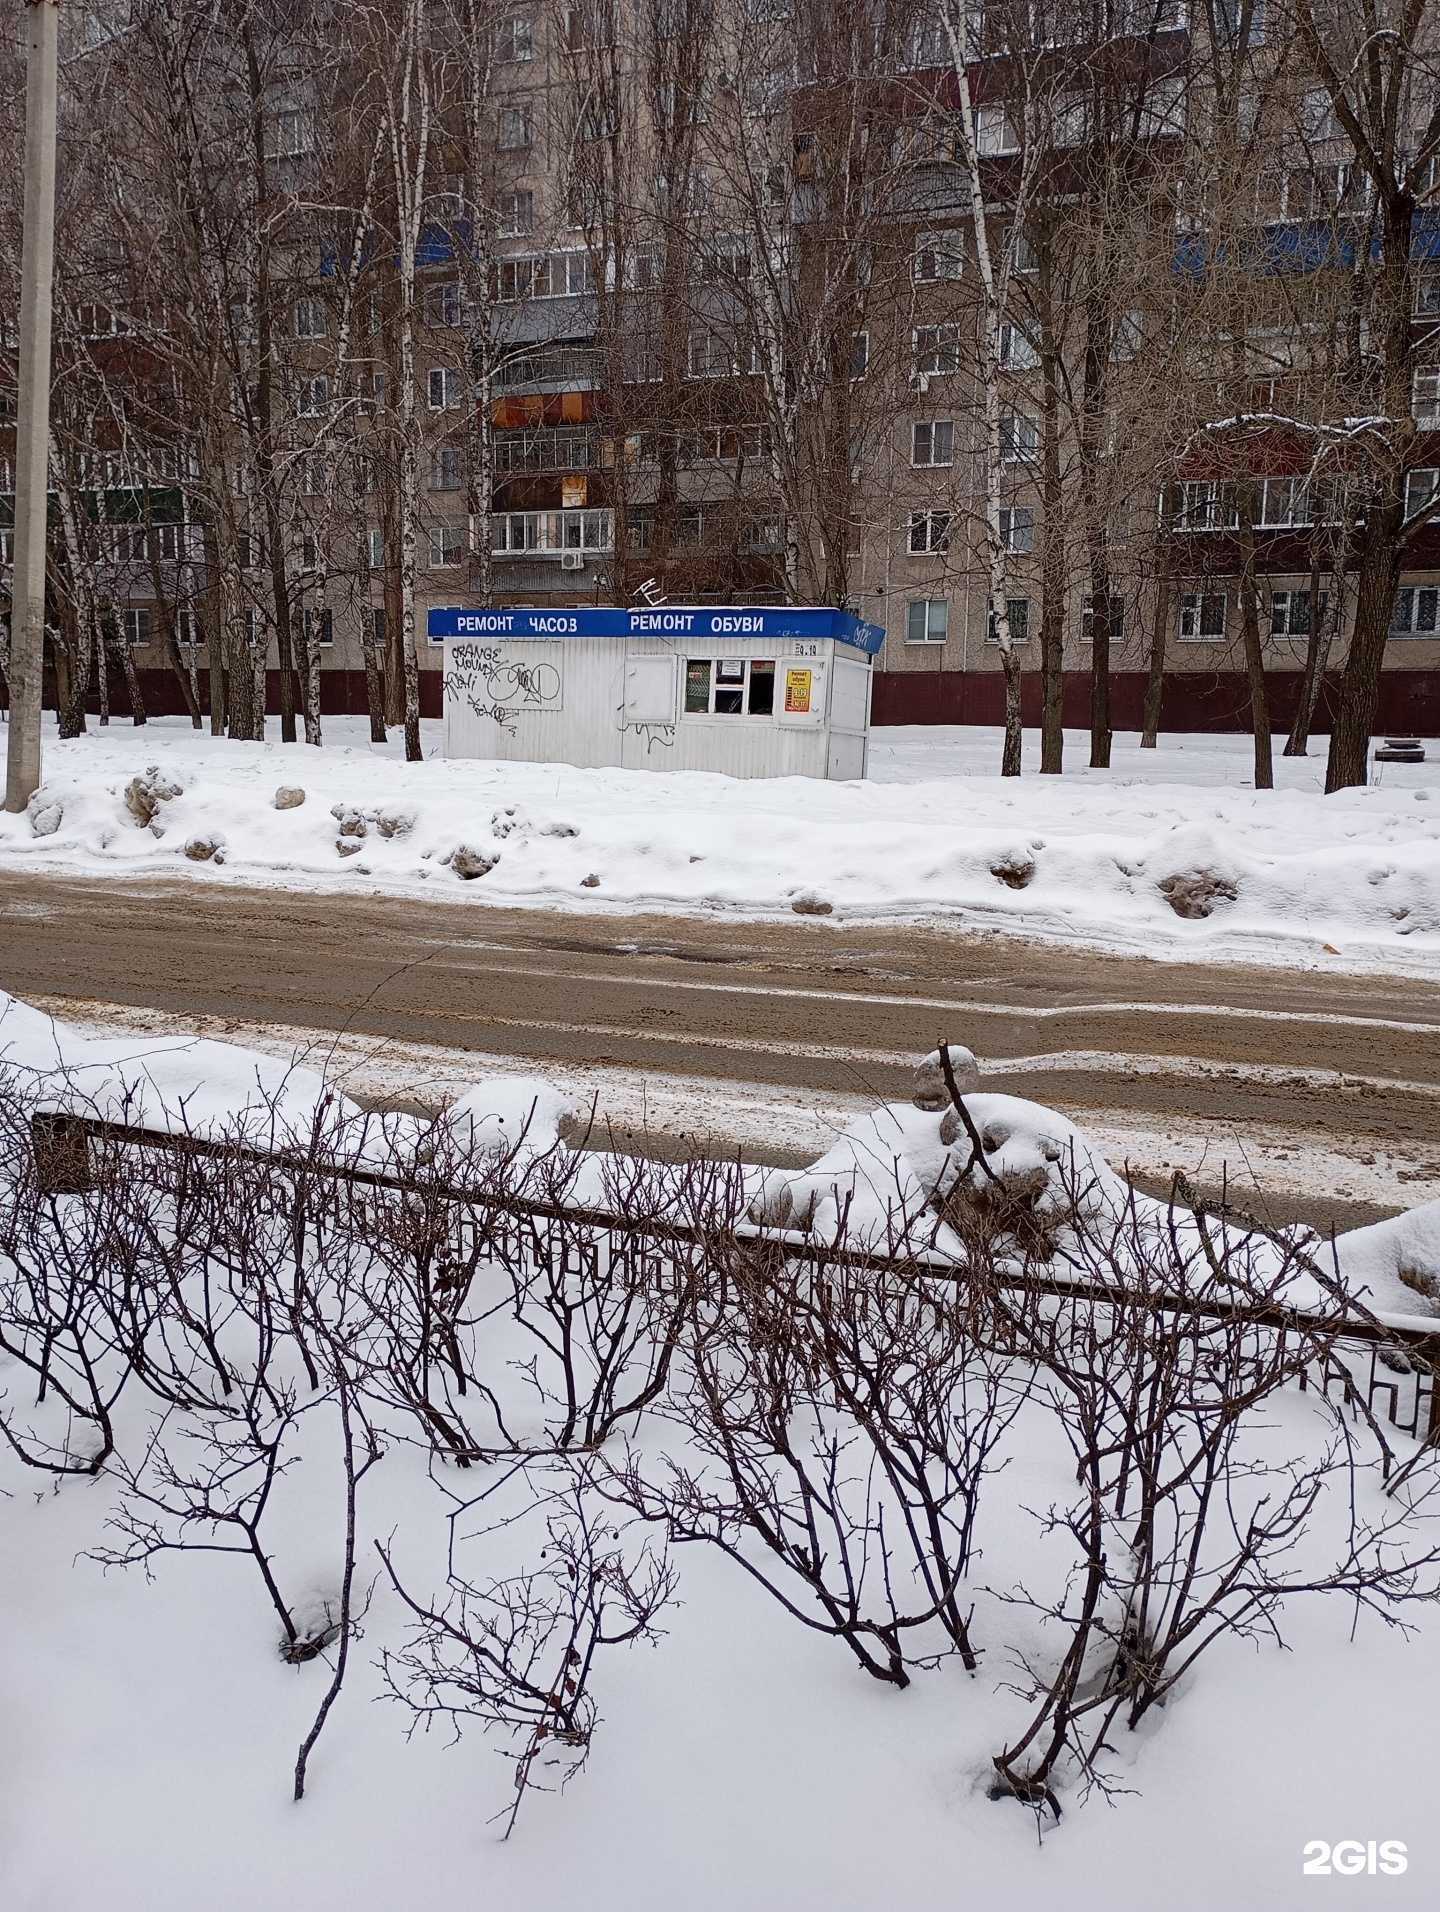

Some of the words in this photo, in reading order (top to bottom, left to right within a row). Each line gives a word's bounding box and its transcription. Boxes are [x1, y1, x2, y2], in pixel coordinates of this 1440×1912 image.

[457, 616, 514, 631] РЕМОНТ
[529, 617, 577, 632] ЧАСОВ
[630, 615, 695, 631] РЕМОНТ
[711, 616, 764, 632] ОБУВИ
